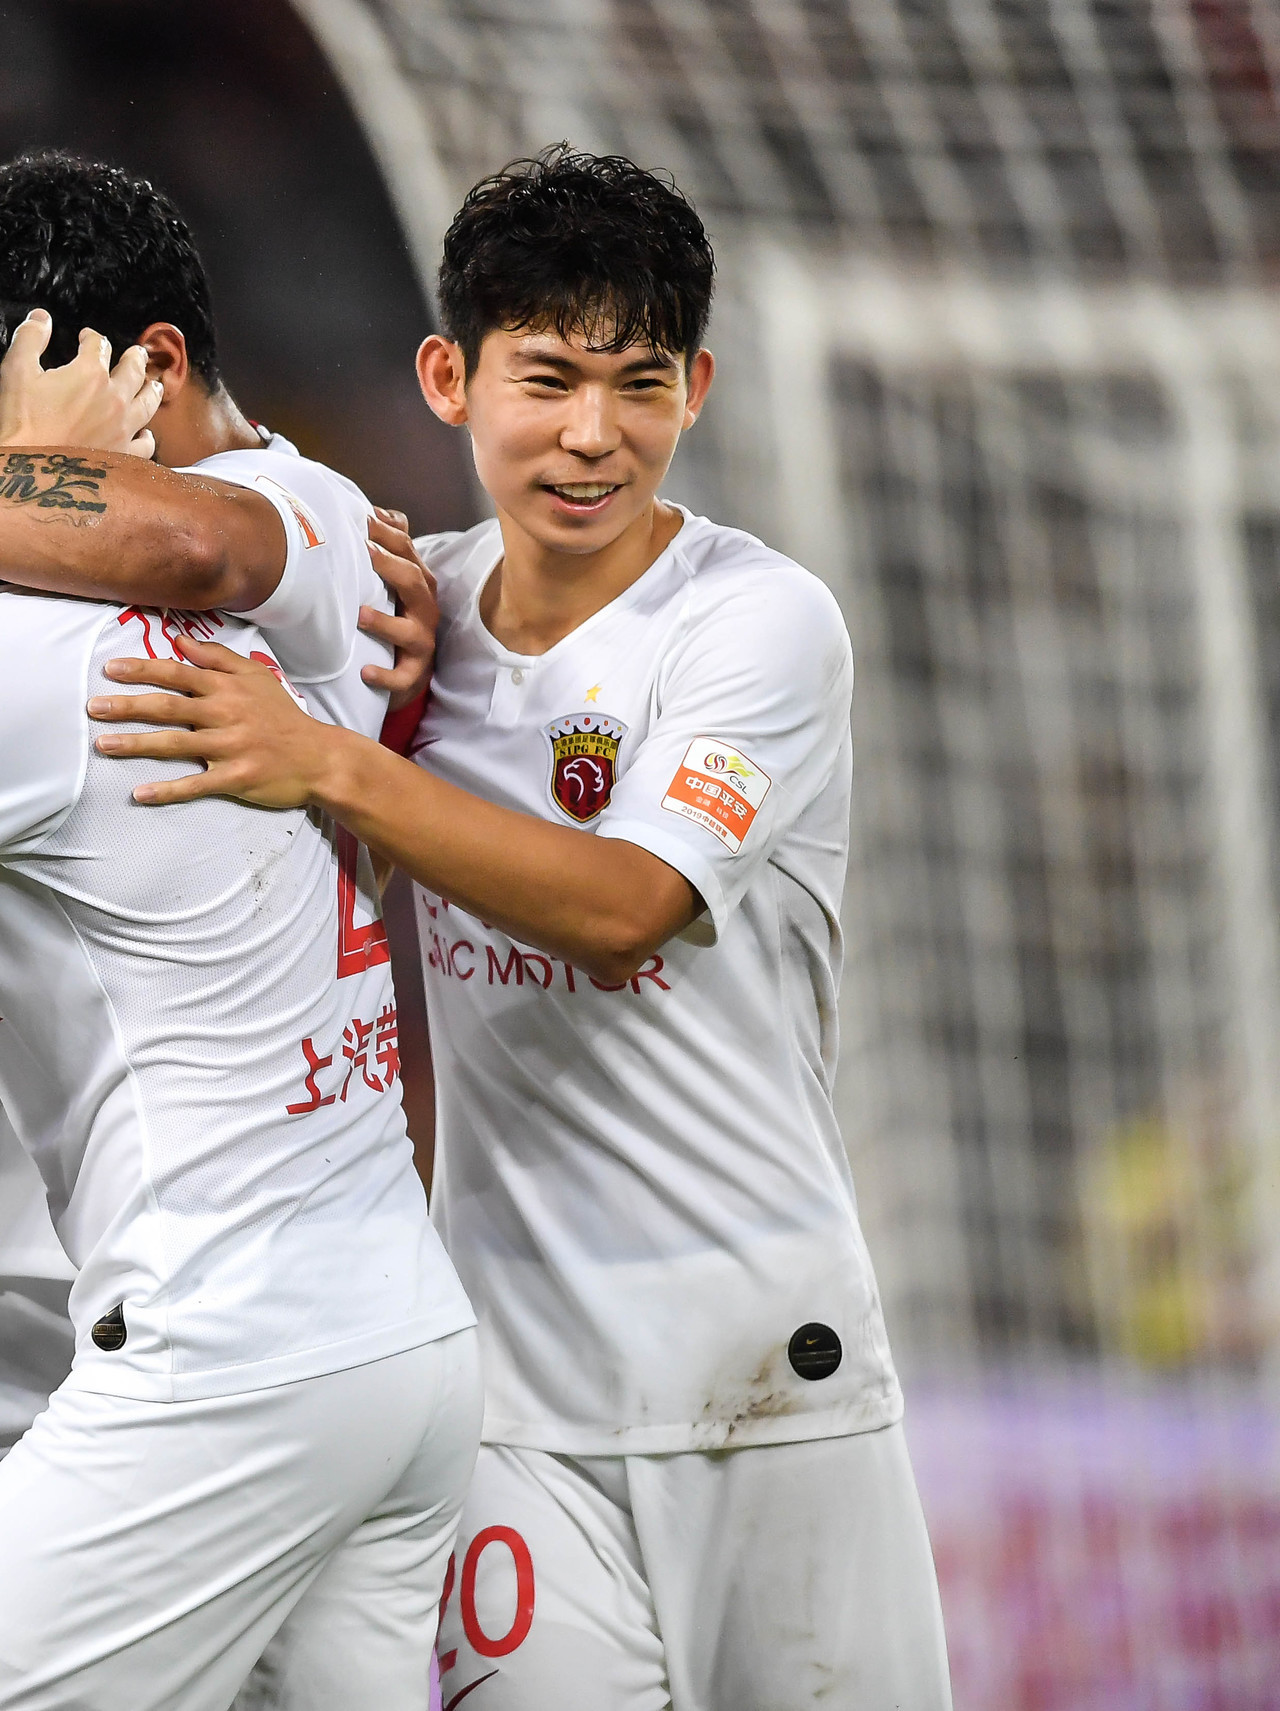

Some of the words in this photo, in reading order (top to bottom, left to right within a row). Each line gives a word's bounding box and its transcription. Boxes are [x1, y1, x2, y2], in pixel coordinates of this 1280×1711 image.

[560, 744, 589, 757] SIPG
[595, 745, 611, 757] FC
[729, 775, 748, 795] CSL
[685, 776, 748, 821] 中国平安
